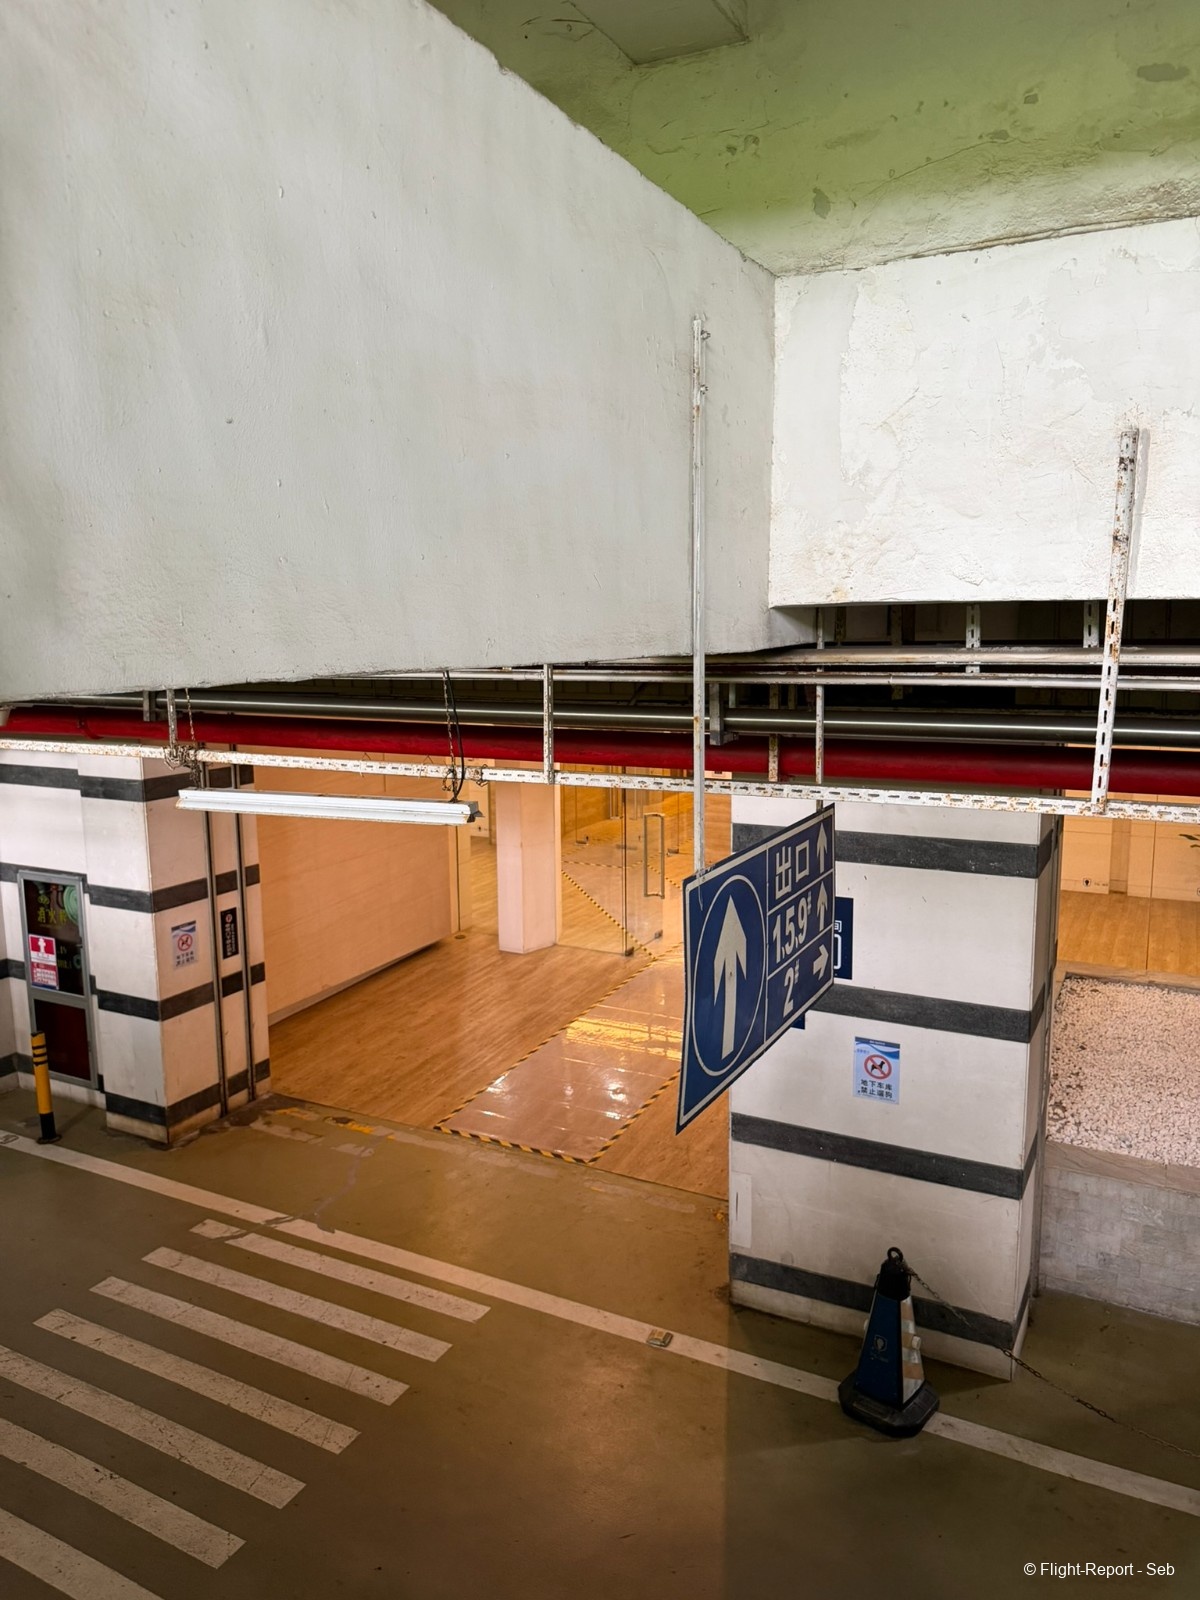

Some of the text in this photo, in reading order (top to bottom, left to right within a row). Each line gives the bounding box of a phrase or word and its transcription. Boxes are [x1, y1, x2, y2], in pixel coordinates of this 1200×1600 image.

[775, 839, 810, 900] 出口
[860, 1079, 893, 1091] 地下车库
